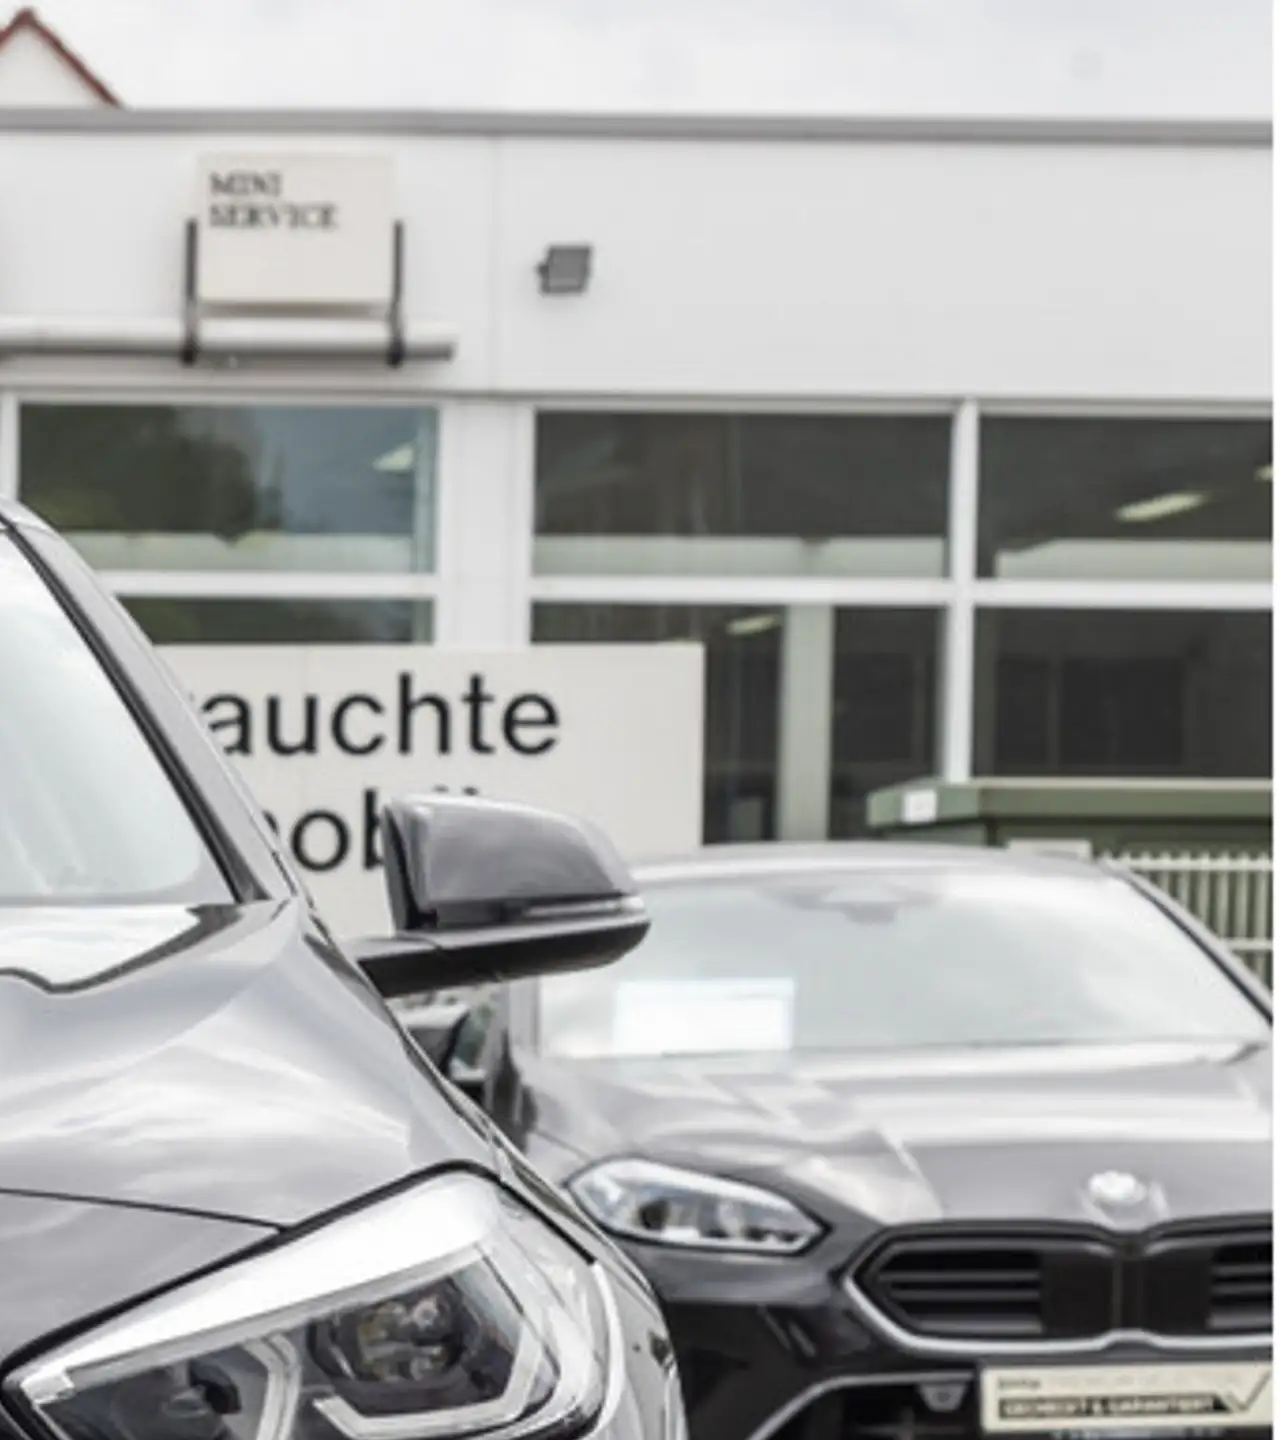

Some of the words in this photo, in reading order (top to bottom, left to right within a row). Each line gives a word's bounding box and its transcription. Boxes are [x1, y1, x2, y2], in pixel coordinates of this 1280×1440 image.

[207, 169, 284, 196] MINI
[208, 201, 337, 230] SERVICE
[190, 671, 560, 757] auchte
